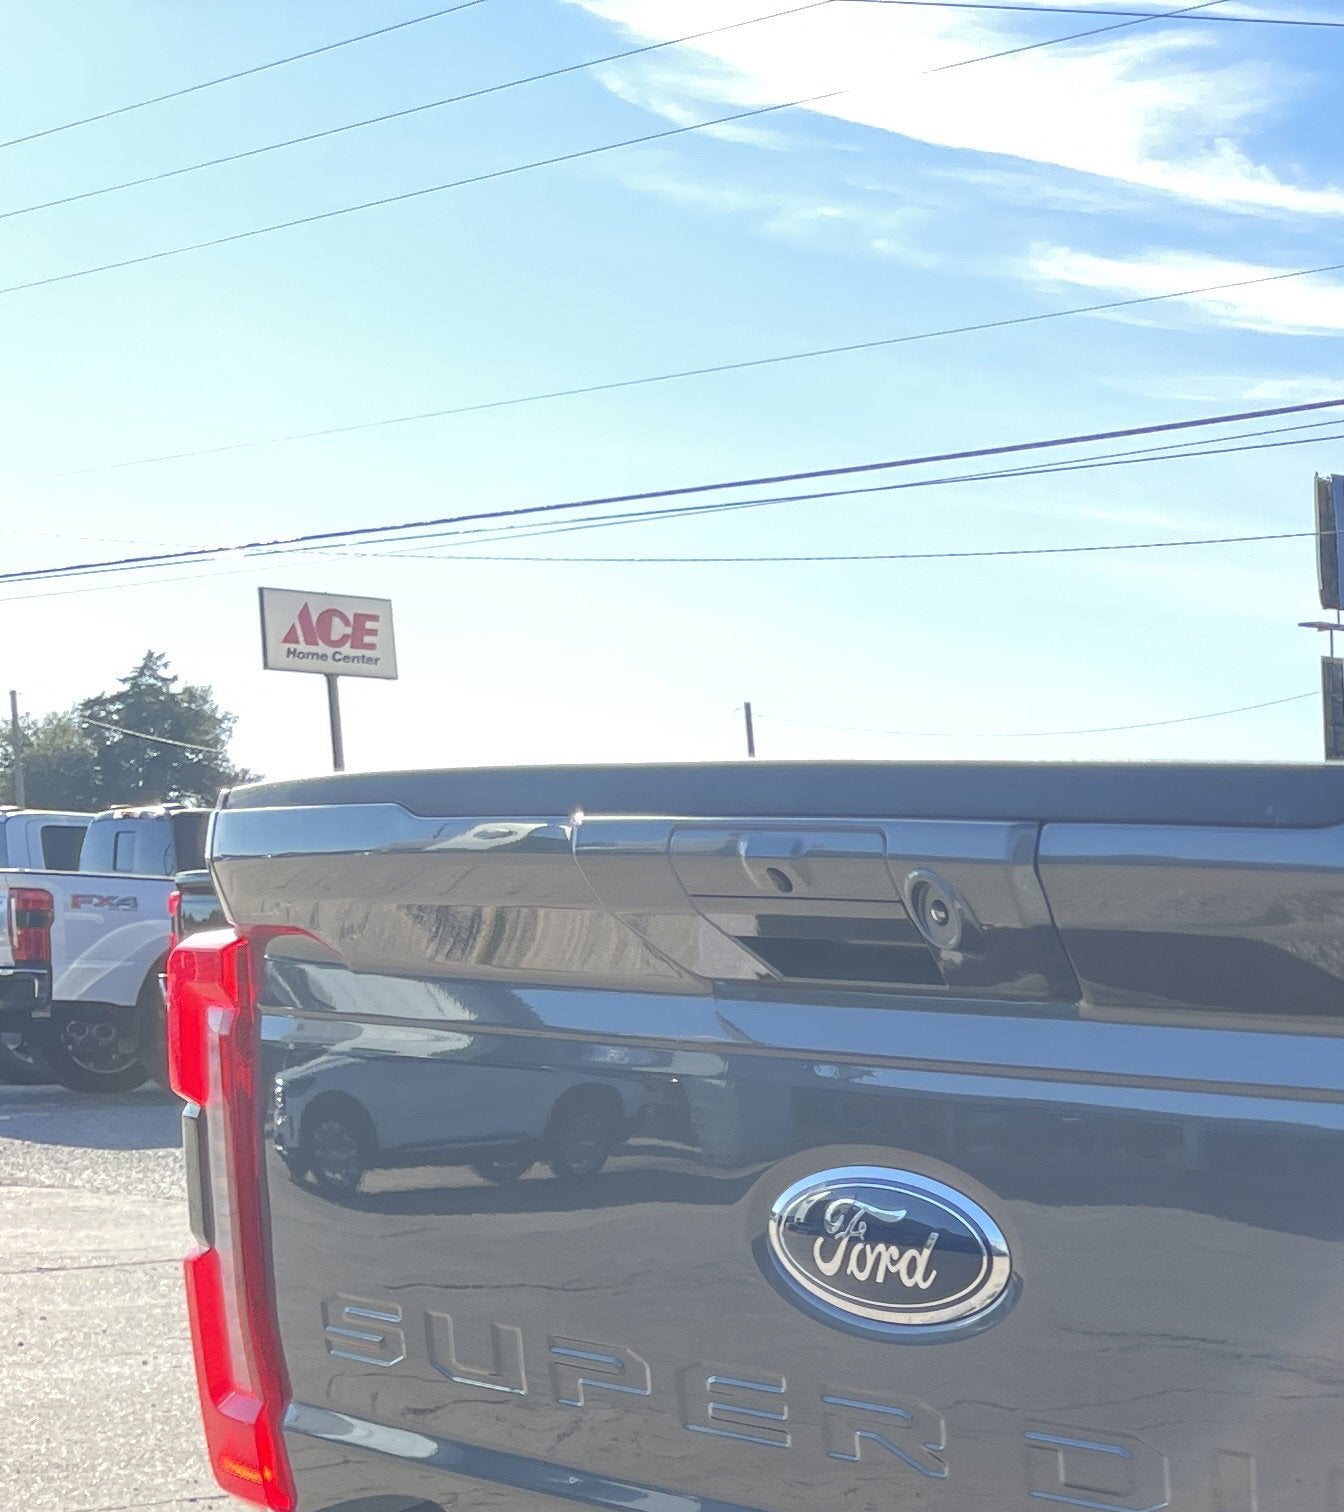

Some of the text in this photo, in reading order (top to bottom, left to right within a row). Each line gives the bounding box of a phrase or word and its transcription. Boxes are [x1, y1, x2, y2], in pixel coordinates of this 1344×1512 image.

[281, 601, 380, 651] ACE
[286, 647, 381, 666] Home Center
[70, 893, 139, 911] FX4
[813, 1197, 941, 1290] Ford
[322, 1289, 956, 1483] SUPER
